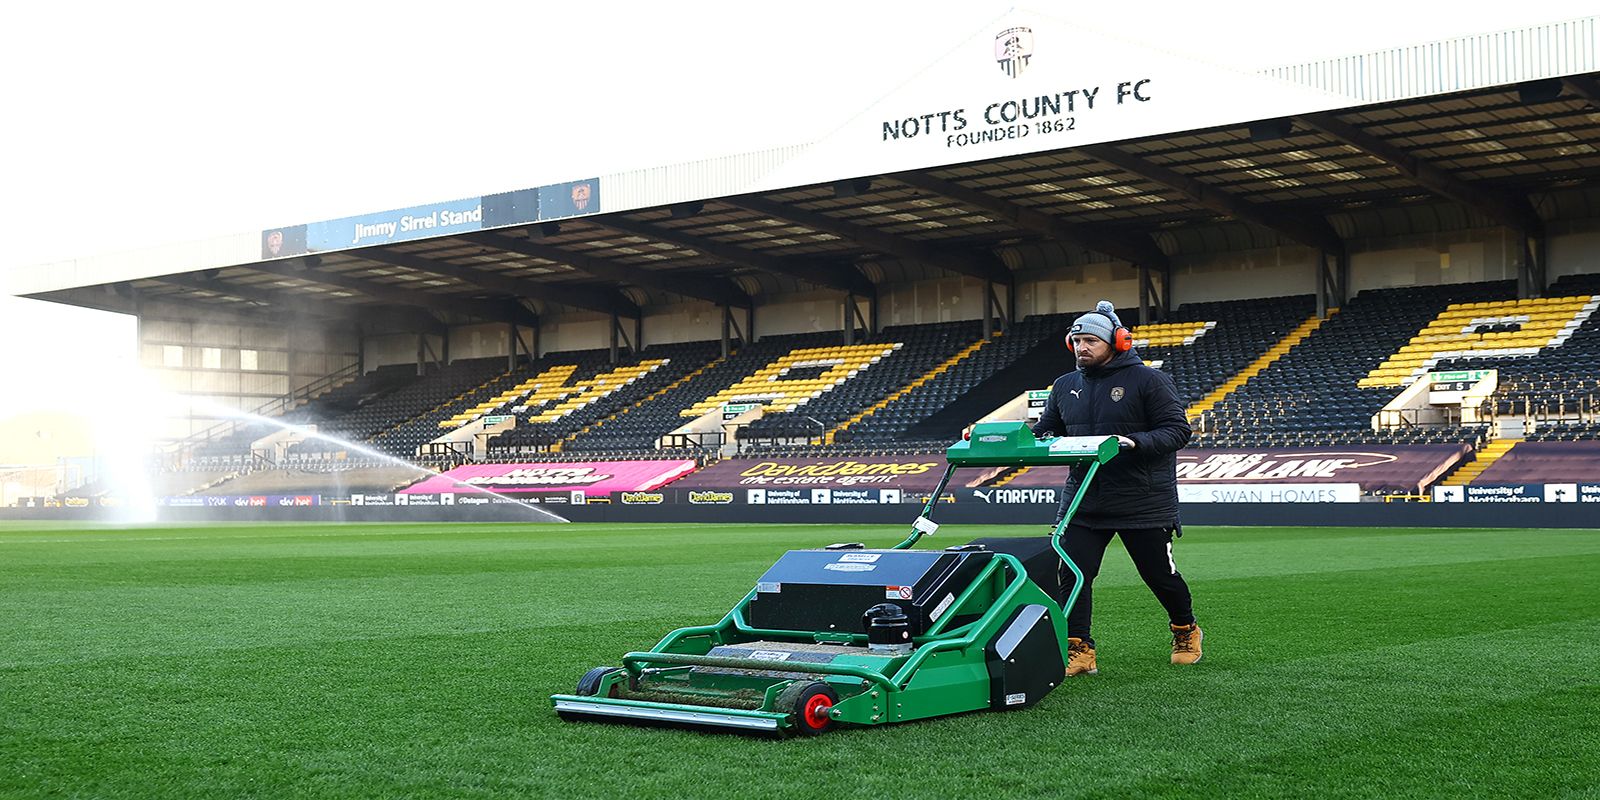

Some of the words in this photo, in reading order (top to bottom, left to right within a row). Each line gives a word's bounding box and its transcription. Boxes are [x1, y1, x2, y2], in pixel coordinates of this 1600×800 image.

[882, 108, 967, 141] NOTTS
[984, 86, 1099, 125] COUNTY
[1117, 78, 1151, 104] FC
[947, 125, 1029, 147] FOUNDED
[1035, 117, 1076, 135] 1862
[352, 221, 397, 244] Jimmy
[400, 211, 438, 232] Sirrel
[440, 204, 482, 227] Stand
[1433, 383, 1451, 391] EXIT
[1456, 382, 1465, 391] 5
[740, 461, 938, 476] DavidJames
[1245, 459, 1356, 479] LANE
[740, 476, 775, 484] the
[772, 476, 835, 484] estate
[835, 475, 898, 486] agent
[767, 490, 794, 498] University
[833, 490, 861, 498] University
[1211, 490, 1262, 503] SWAN
[1271, 489, 1337, 503] HOMES
[1468, 487, 1513, 496] University
[1513, 486, 1525, 494] of
[1468, 495, 1541, 503] Nottingham
